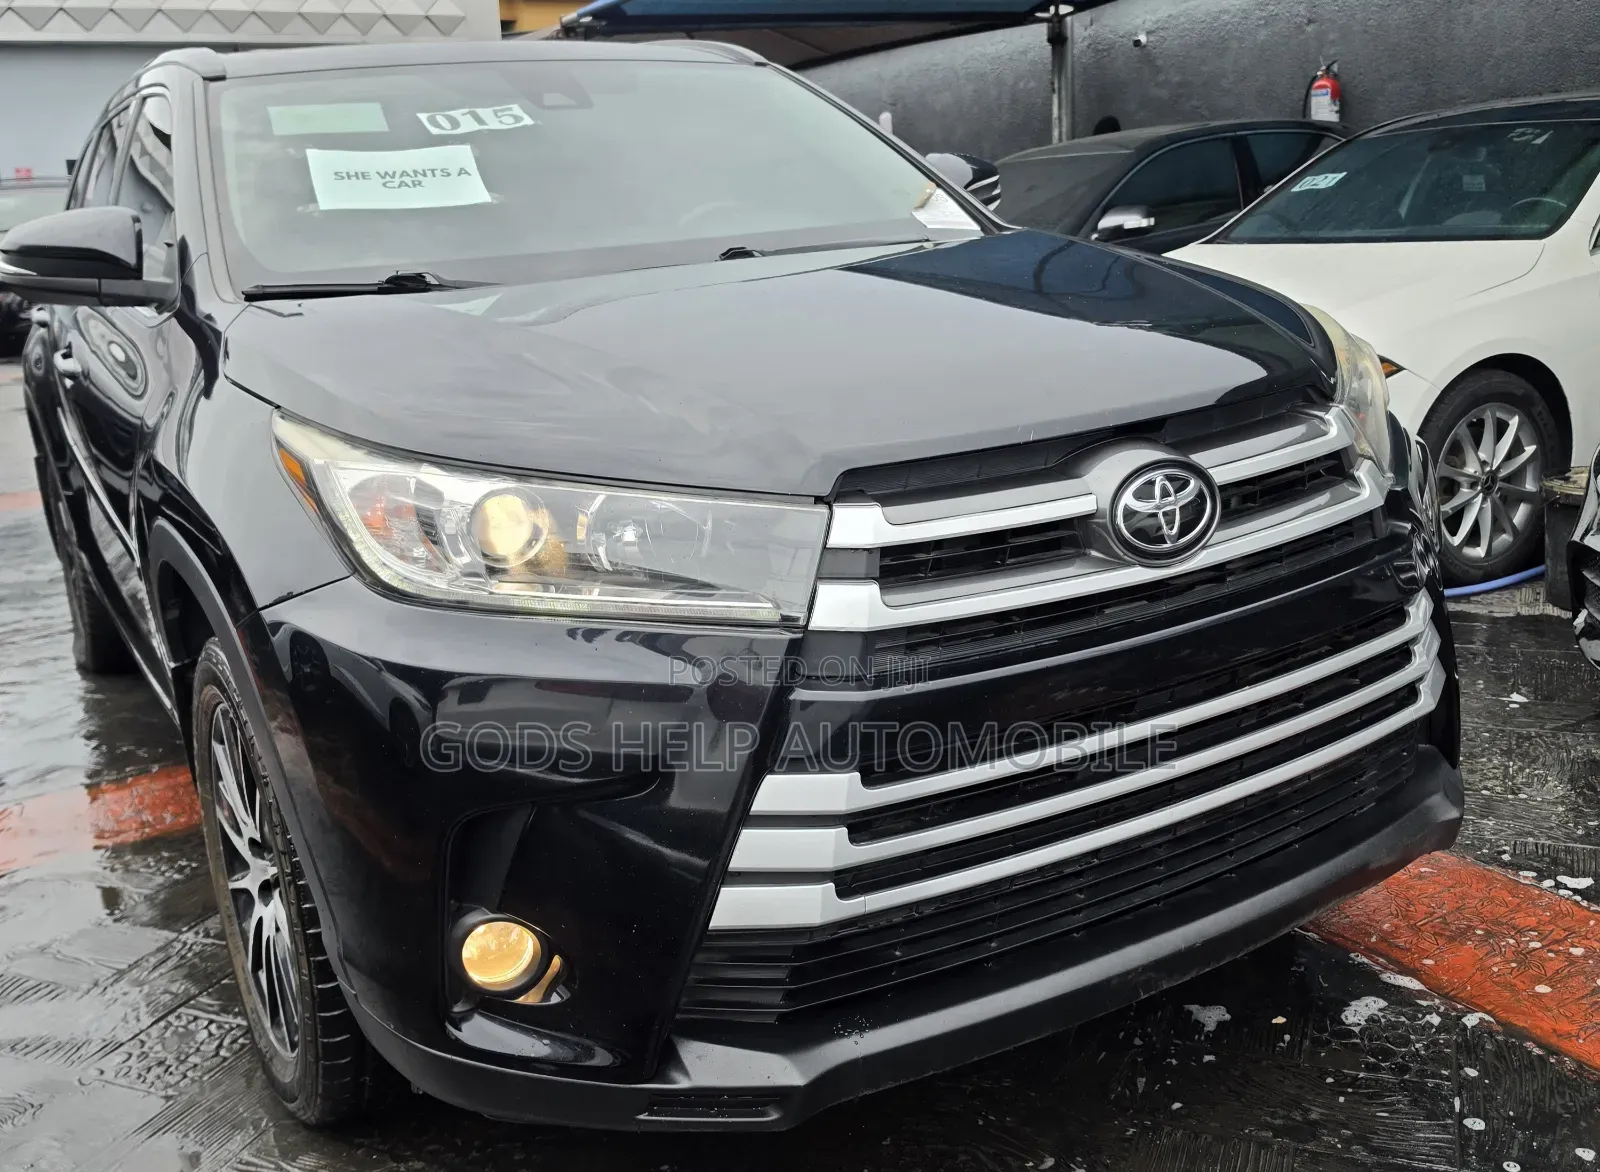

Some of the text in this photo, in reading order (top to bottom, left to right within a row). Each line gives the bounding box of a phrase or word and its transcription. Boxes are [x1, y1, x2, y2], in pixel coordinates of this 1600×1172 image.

[427, 107, 525, 131] 015
[333, 167, 472, 181] SHE WANTS A
[382, 179, 425, 189] CAR
